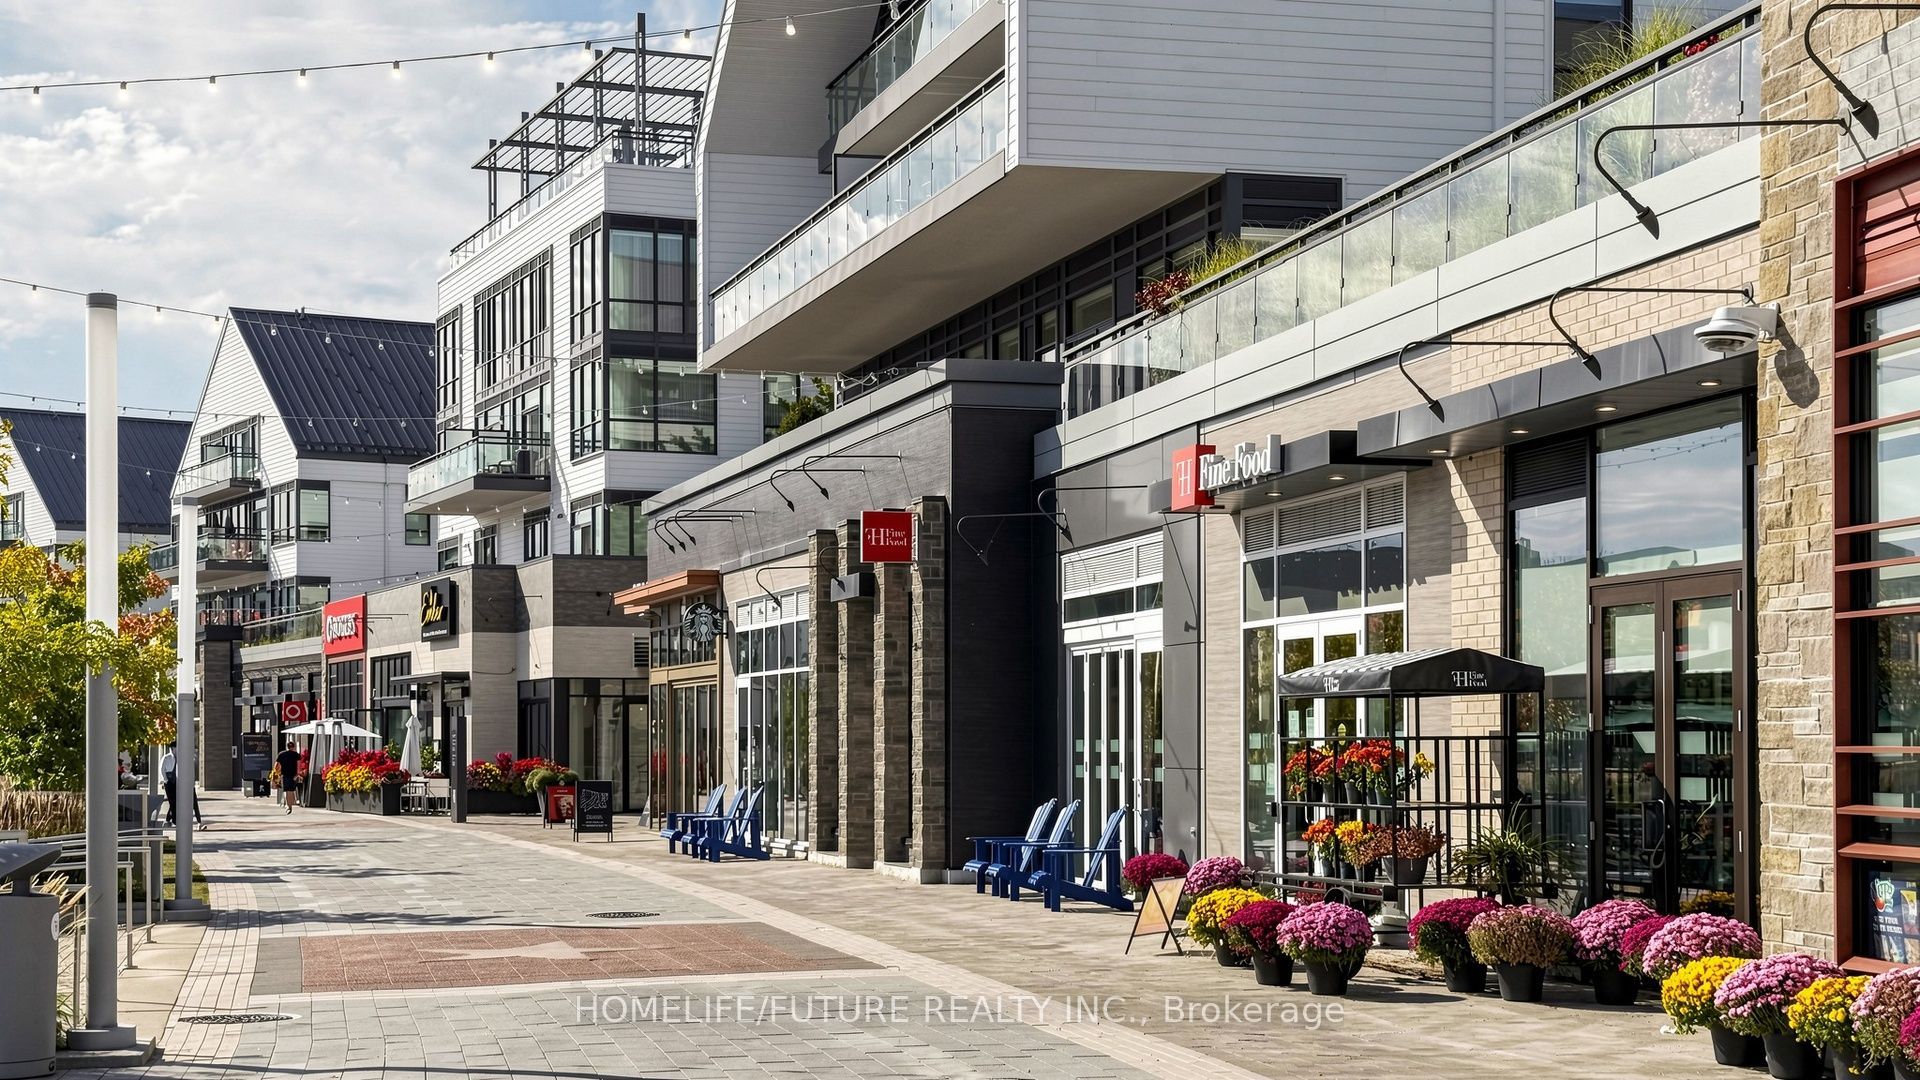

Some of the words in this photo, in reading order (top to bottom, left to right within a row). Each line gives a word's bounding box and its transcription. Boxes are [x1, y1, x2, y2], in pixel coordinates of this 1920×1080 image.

[1198, 454, 1231, 491] Fine
[1231, 434, 1273, 482] Food
[885, 528, 906, 538] Fine
[886, 537, 907, 546] Food
